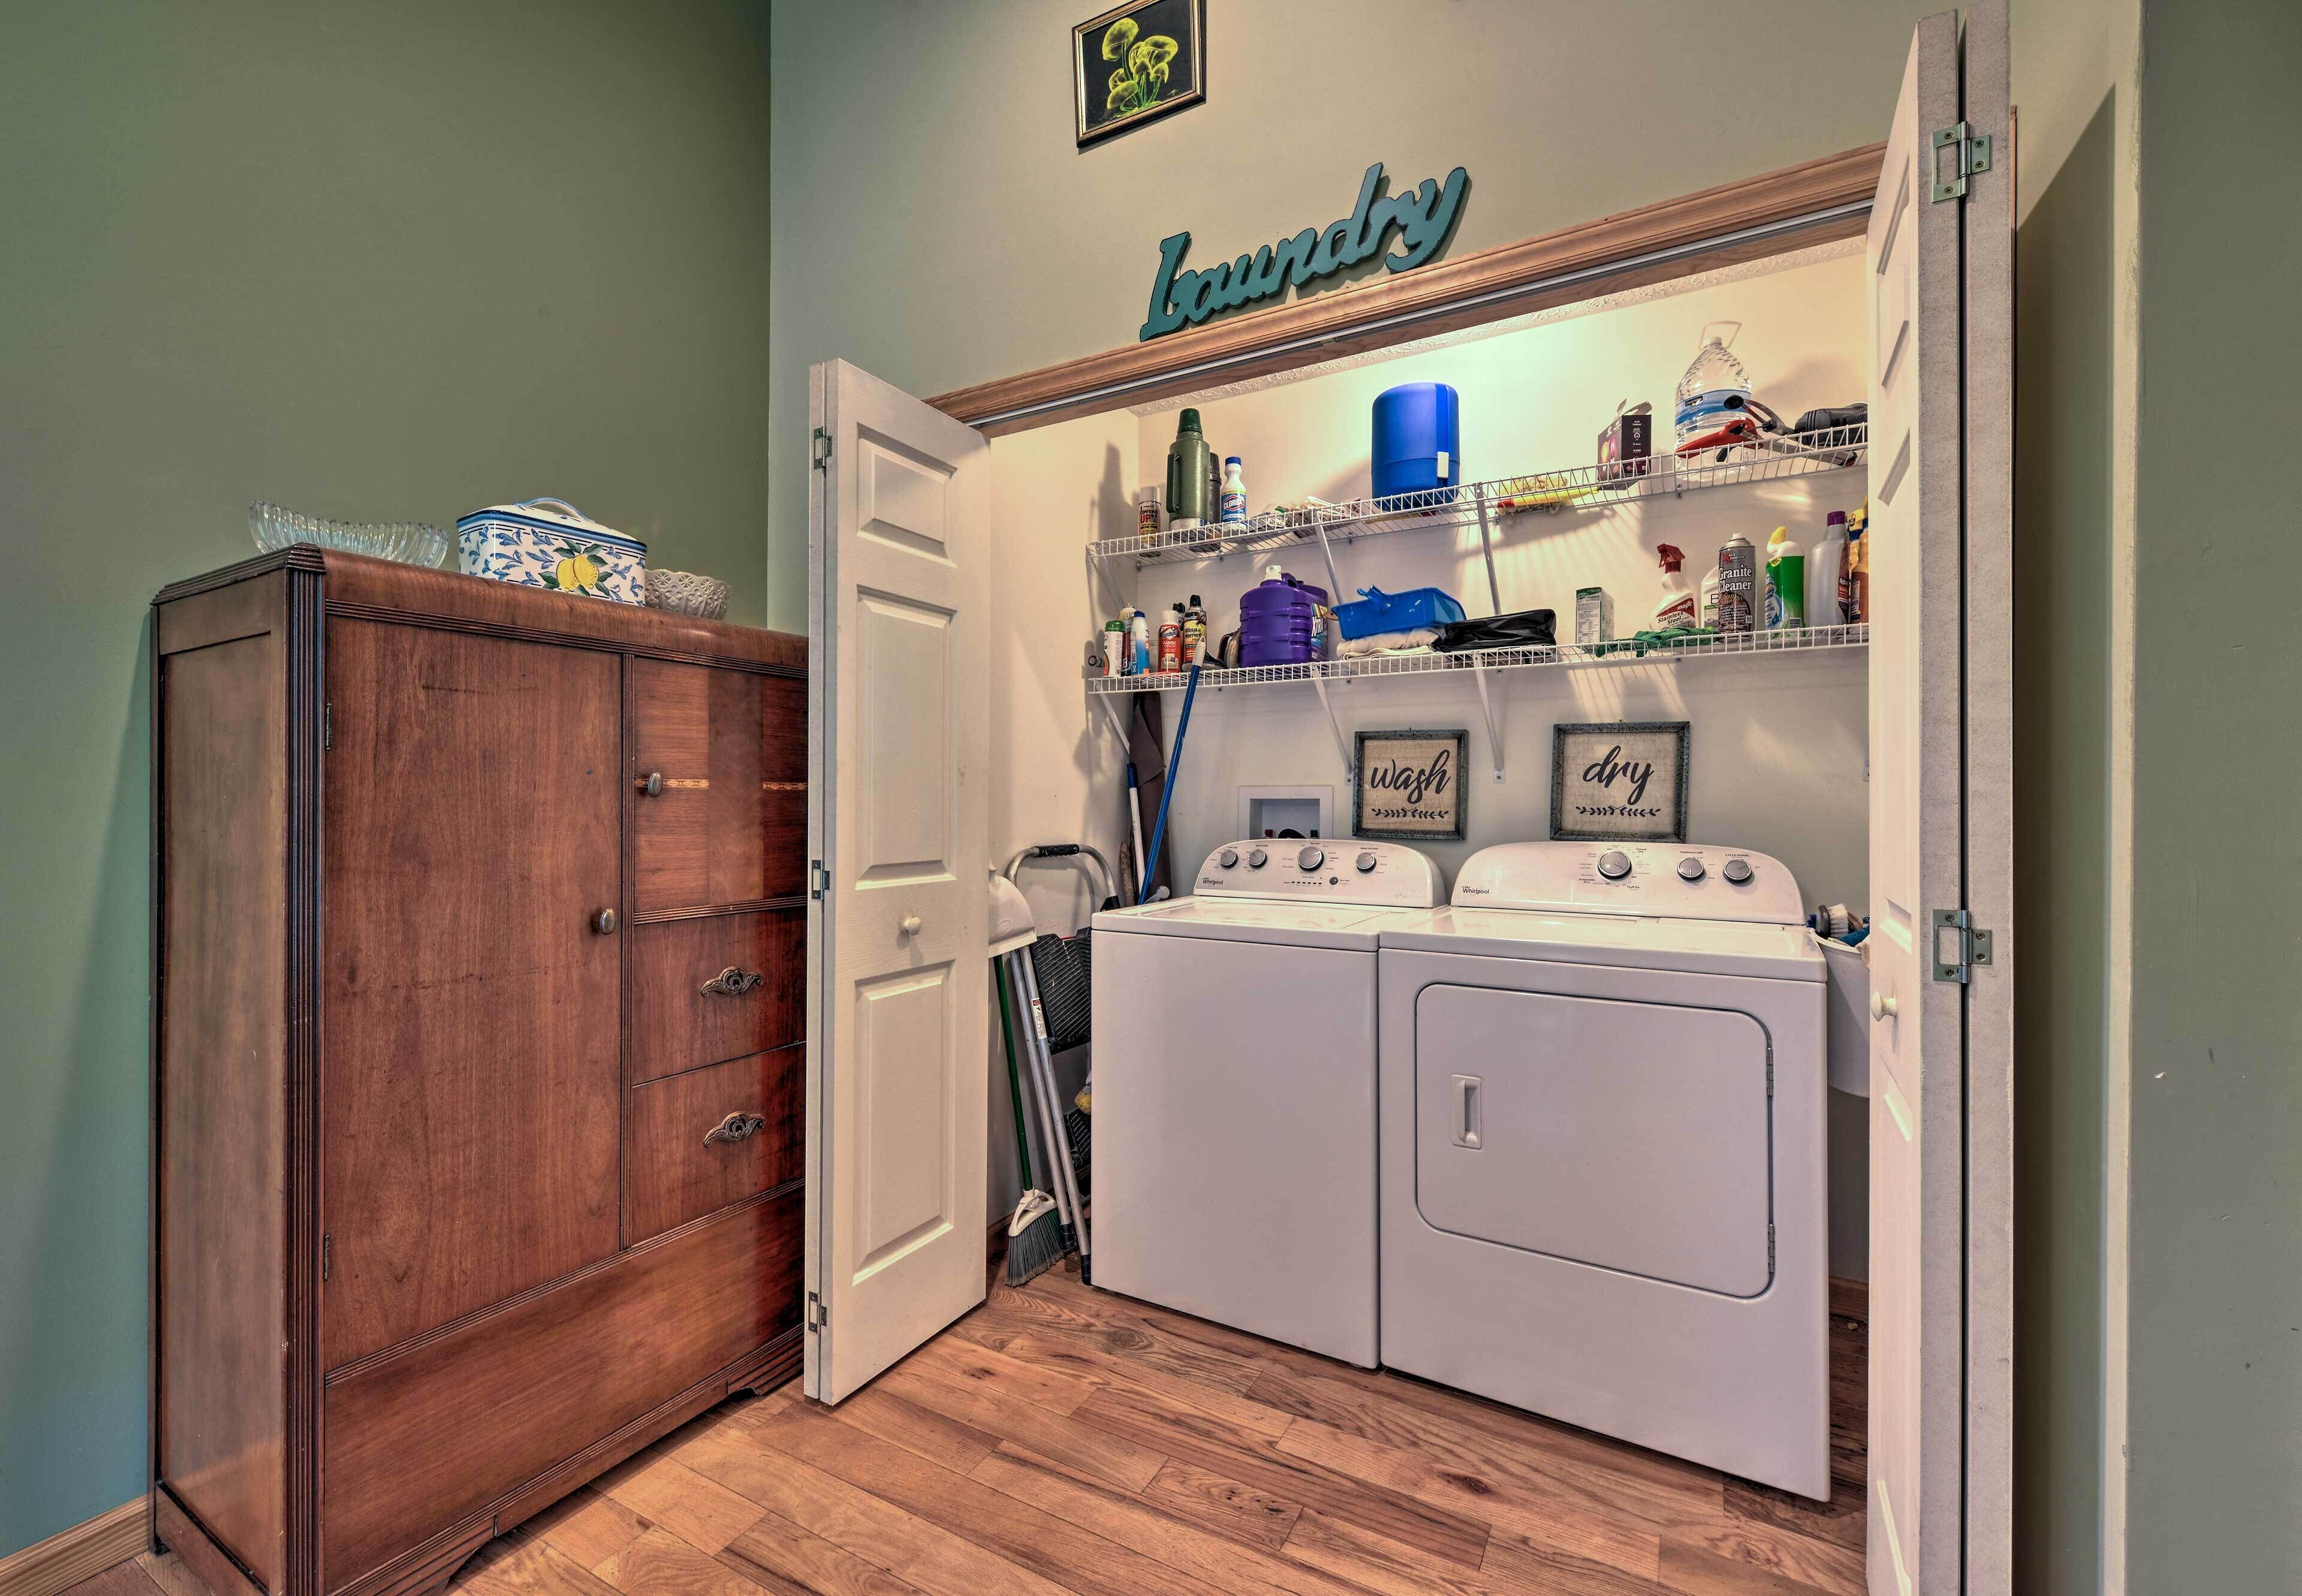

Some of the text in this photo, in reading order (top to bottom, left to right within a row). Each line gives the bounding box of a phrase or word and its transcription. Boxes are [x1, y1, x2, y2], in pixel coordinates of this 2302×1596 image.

[1223, 499, 1243, 509] CLOROX
[1719, 564, 1752, 580] Granite
[1719, 580, 1752, 593] Cleaner
[1677, 601, 1692, 610] magic
[1658, 611, 1683, 623] Stainless
[1667, 616, 1682, 624] Steel
[1370, 749, 1451, 804] wash
[1582, 745, 1655, 805] dry
